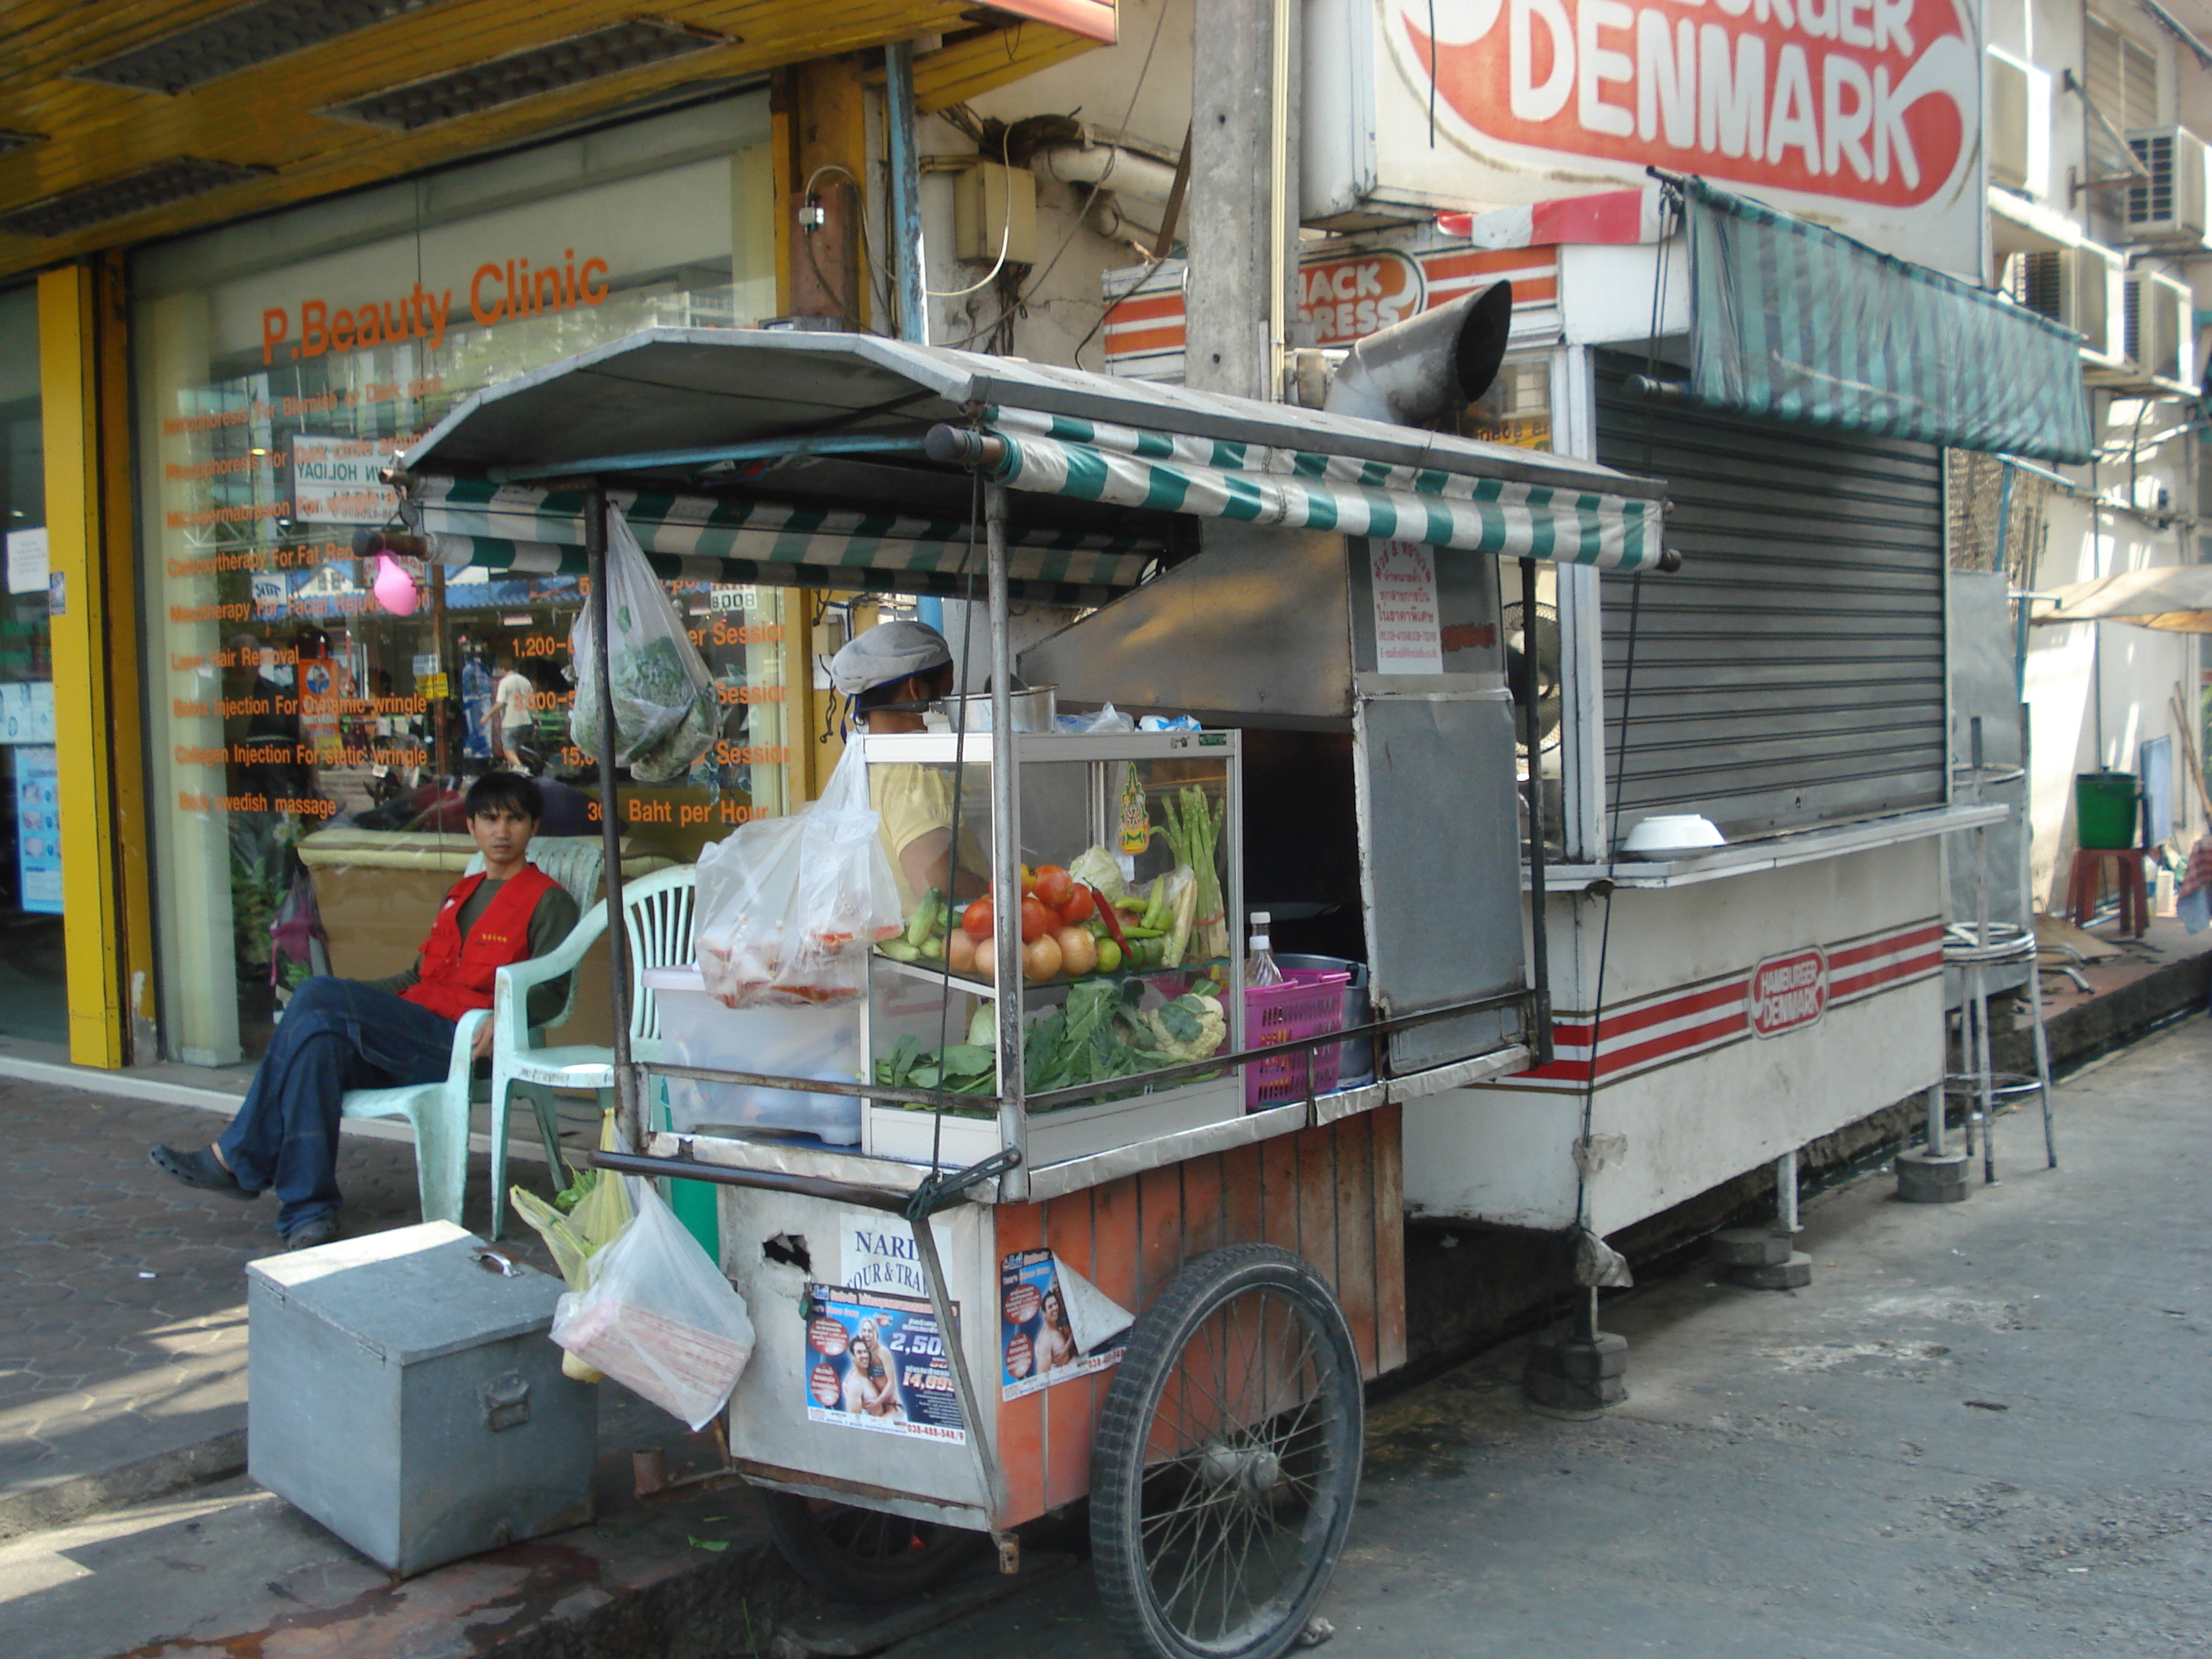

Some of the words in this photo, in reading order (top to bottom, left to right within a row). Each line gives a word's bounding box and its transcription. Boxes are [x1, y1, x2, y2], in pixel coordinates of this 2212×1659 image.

[1511, 0, 1955, 189] DENMARK
[263, 282, 451, 366] P.Beauty
[470, 248, 609, 328] Clinic
[254, 402, 276, 421] For
[283, 391, 338, 417] Blemish
[365, 381, 400, 405] Dark
[408, 372, 443, 400] spot
[265, 450, 288, 468] For
[271, 547, 295, 567] For
[297, 544, 320, 564] Fat
[256, 596, 279, 616] For
[210, 648, 236, 667] Hair
[241, 644, 299, 666] Removal
[214, 694, 269, 719] Injection
[275, 694, 298, 714] For
[372, 692, 426, 717] wringle
[233, 743, 291, 767] Injection
[297, 744, 320, 764] For
[325, 745, 364, 765] static
[373, 745, 428, 768] wringle
[215, 792, 268, 812] swedish
[274, 797, 336, 819] massage
[629, 799, 672, 823] Baht
[680, 800, 712, 827] per
[884, 1262, 894, 1282] &
